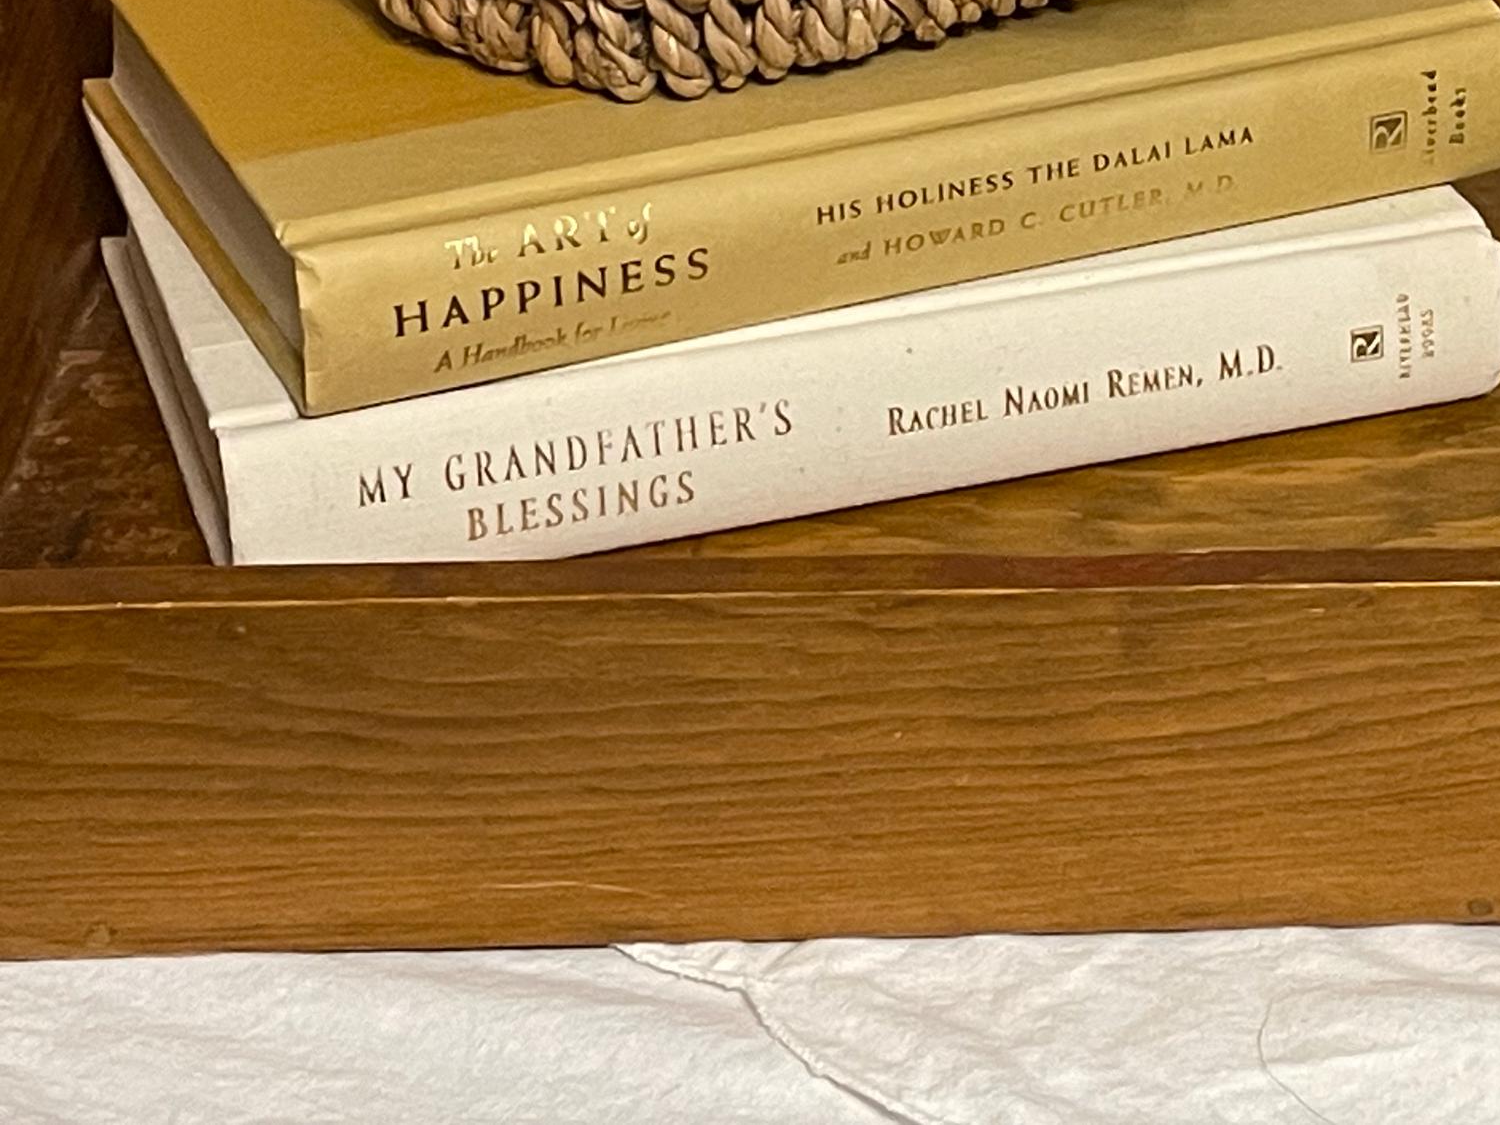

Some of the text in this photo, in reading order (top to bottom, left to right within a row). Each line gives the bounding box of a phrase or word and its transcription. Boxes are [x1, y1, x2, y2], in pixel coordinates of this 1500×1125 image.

[816, 126, 1254, 226] HIS HOLINESS THE DALAI LAMA
[444, 202, 653, 270] The ART of
[836, 240, 872, 265] and
[884, 218, 1006, 257] HOWARD
[393, 246, 710, 338] HAPPINESS
[433, 349, 453, 373] A
[575, 321, 604, 347] for
[886, 343, 1284, 436] RACHEL NAOMI REMEN, M.D.
[357, 398, 795, 509] MY GRANDFATHER'S
[467, 469, 696, 542] BLESSINGS
